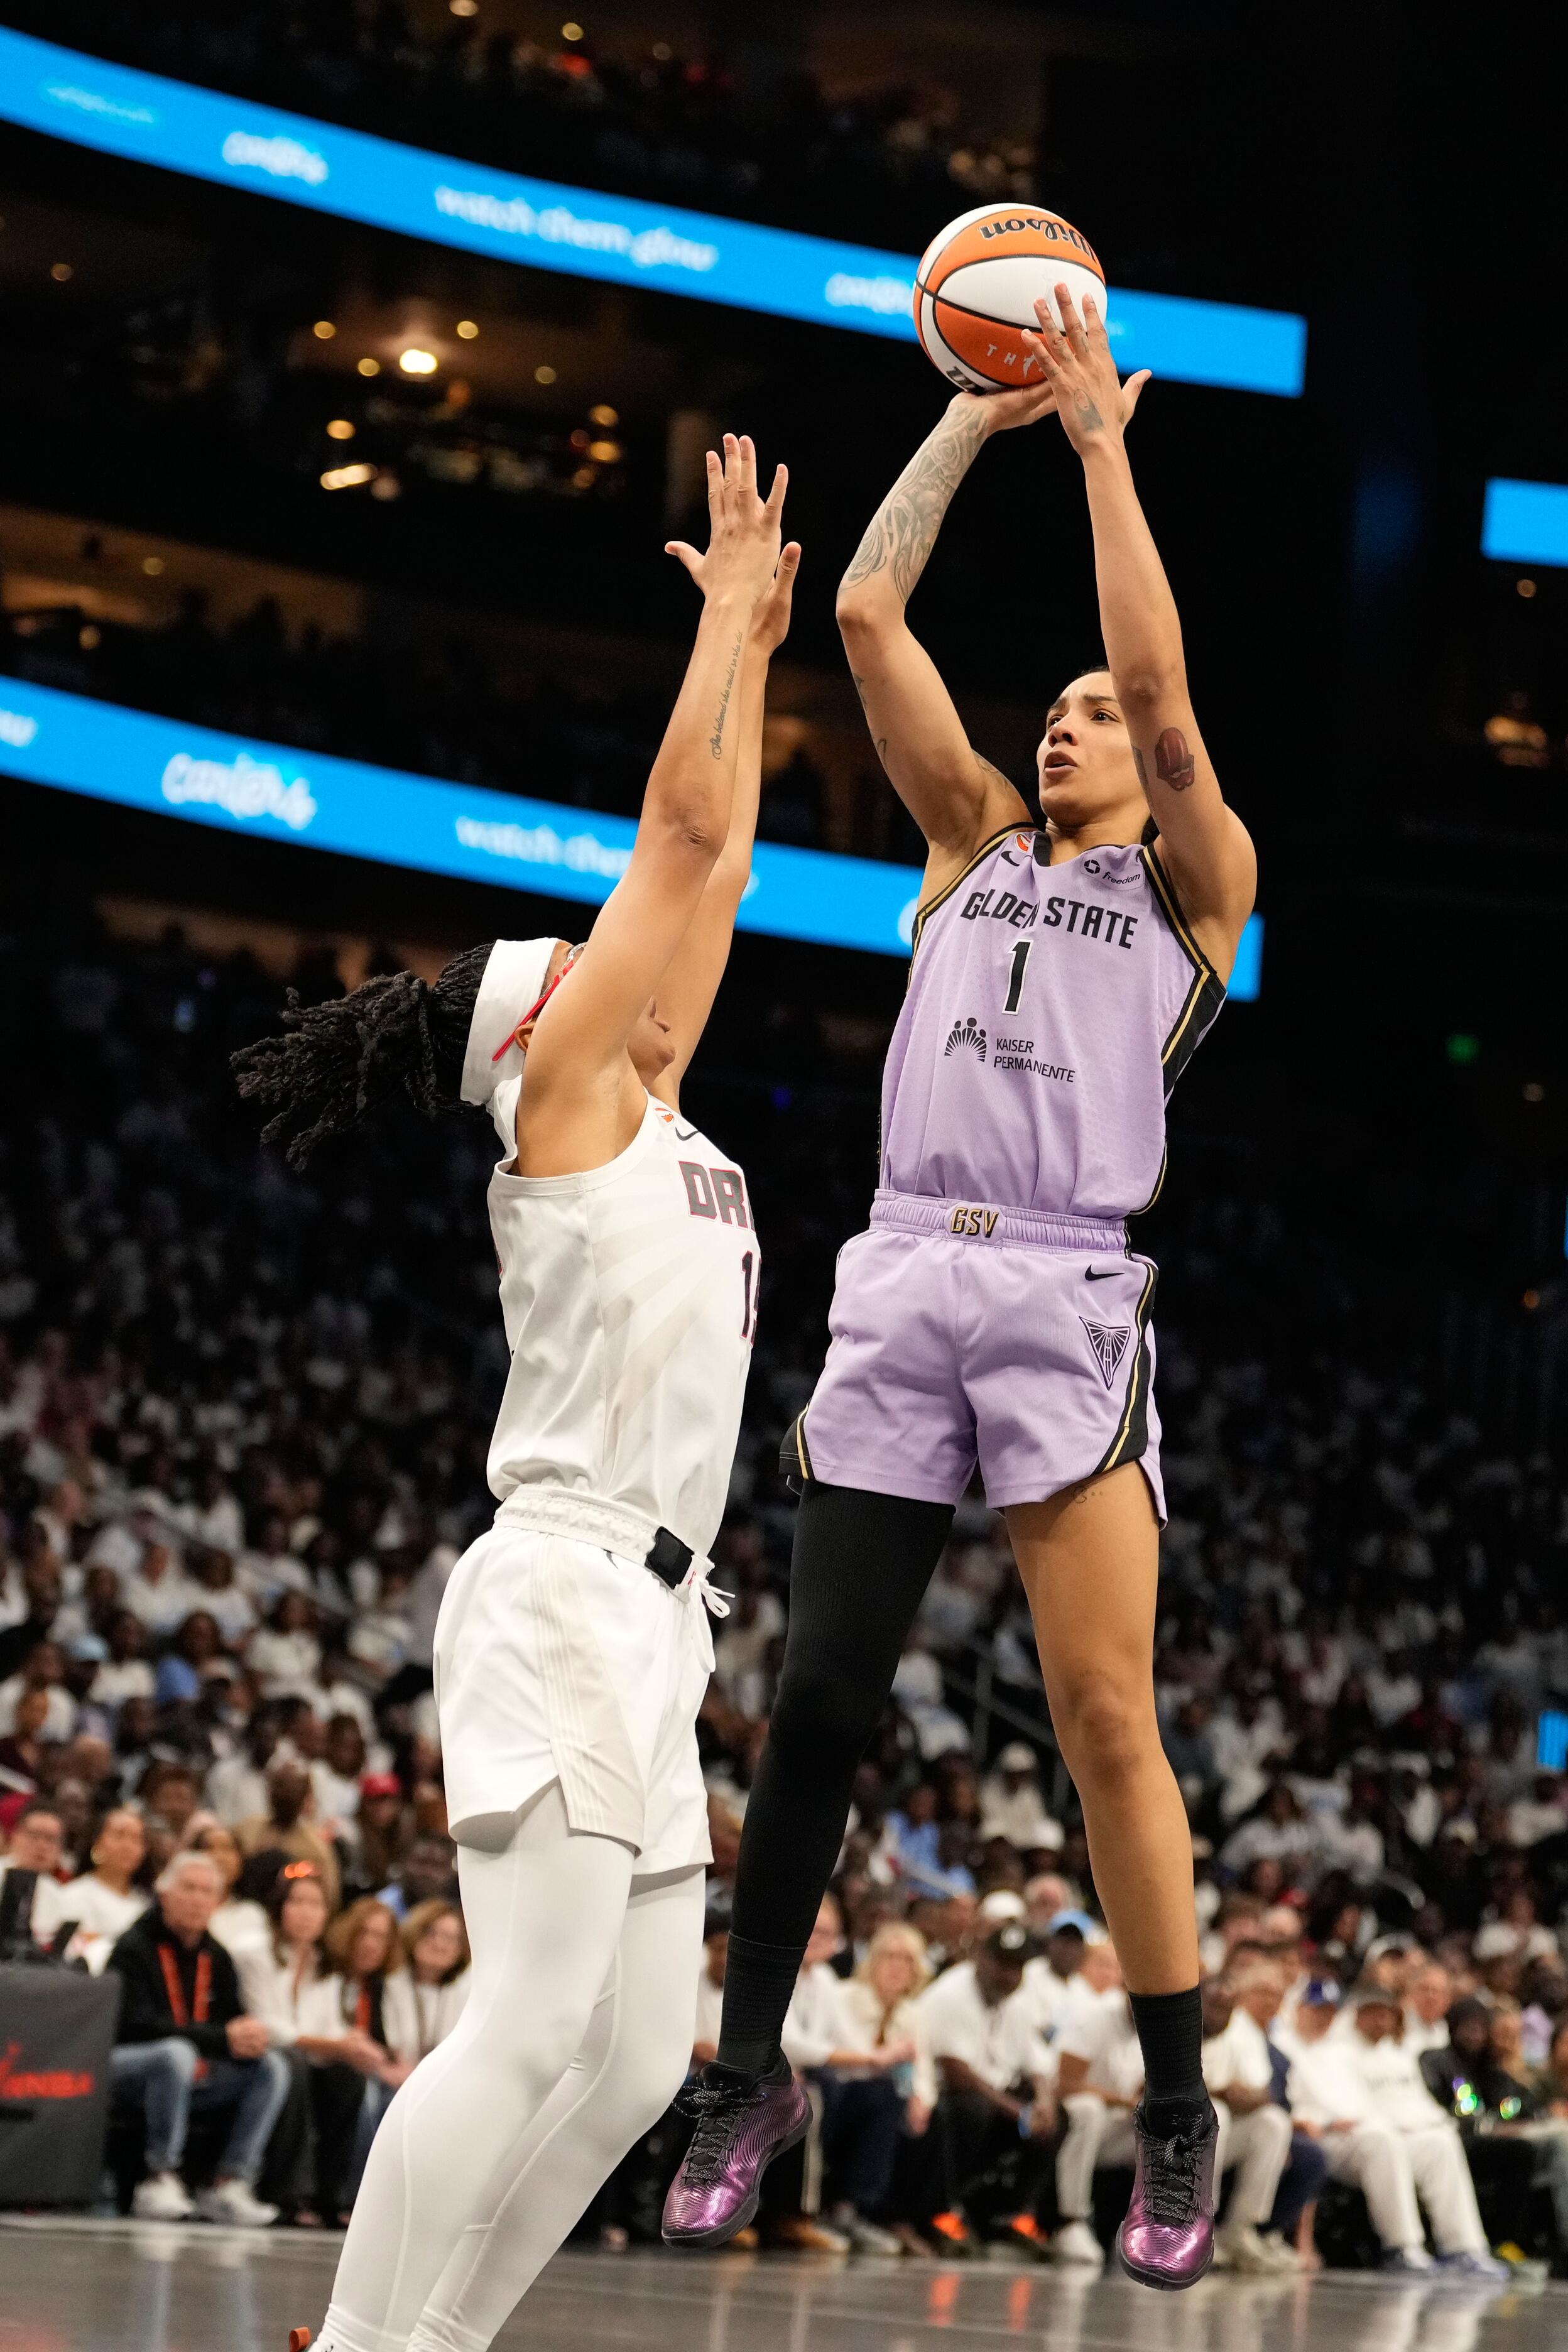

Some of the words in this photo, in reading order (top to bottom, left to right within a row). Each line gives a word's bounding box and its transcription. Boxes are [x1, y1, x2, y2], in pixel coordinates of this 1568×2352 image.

[979, 218, 1097, 264] Wilson
[1102, 871, 1141, 885] freedom
[960, 889, 1040, 929] GLDEN
[1043, 896, 1138, 949] STATE
[1002, 939, 1034, 1015] 1
[994, 1055, 1075, 1082] PERMANENTE
[996, 1038, 1034, 1054] KAISER
[678, 1160, 756, 1234] DR
[951, 1207, 999, 1238] GSV
[741, 1250, 762, 1346] 1
